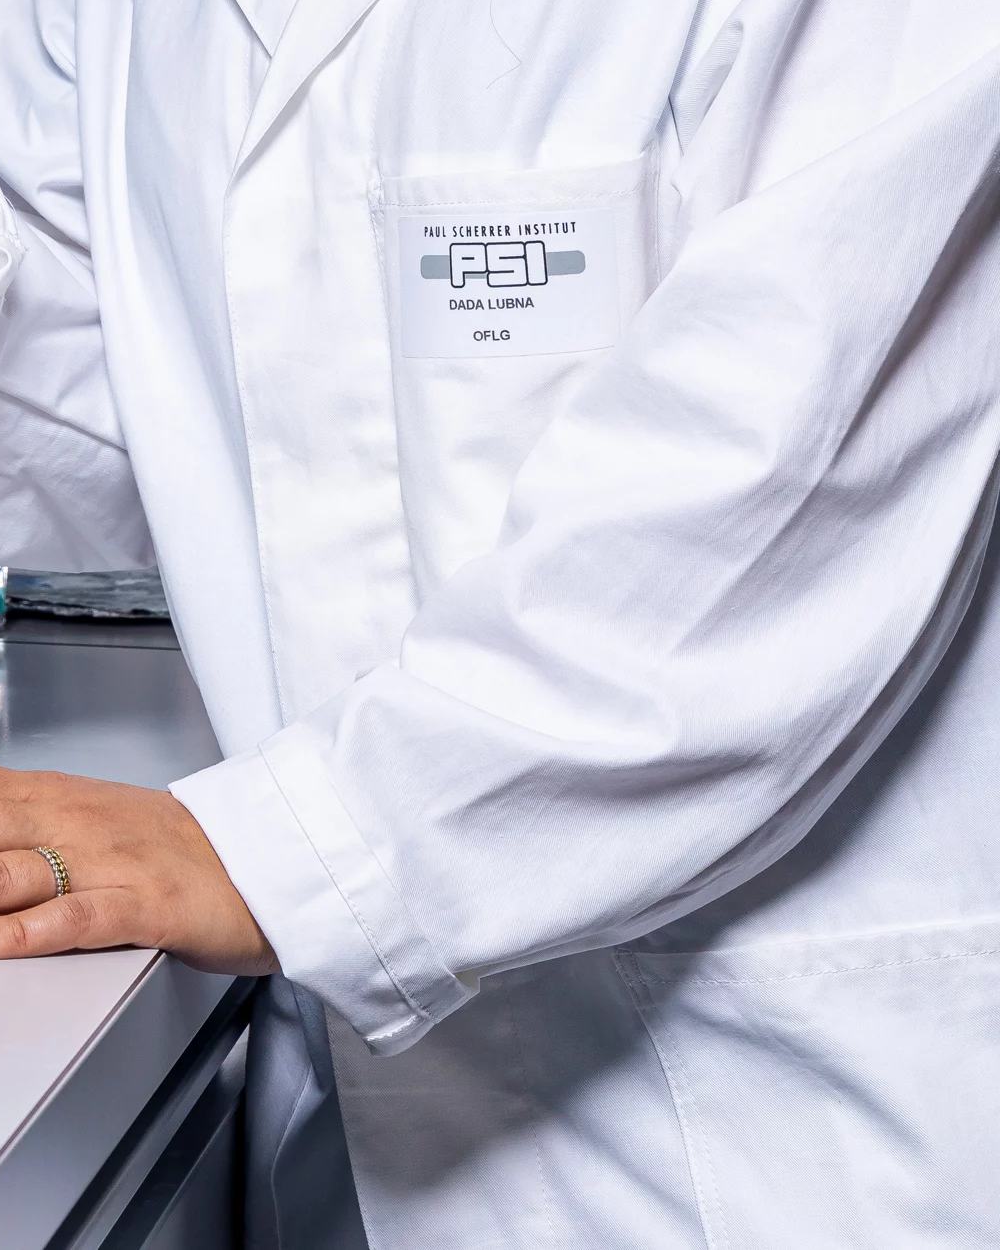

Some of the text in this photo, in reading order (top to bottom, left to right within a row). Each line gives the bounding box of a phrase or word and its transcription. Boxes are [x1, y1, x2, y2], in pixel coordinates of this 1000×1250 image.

[424, 221, 577, 238] PAUL SCHERRER INSTITUT
[449, 240, 548, 288] PSI
[449, 297, 534, 311] DADA LUBNA
[473, 330, 511, 341] OFLG
